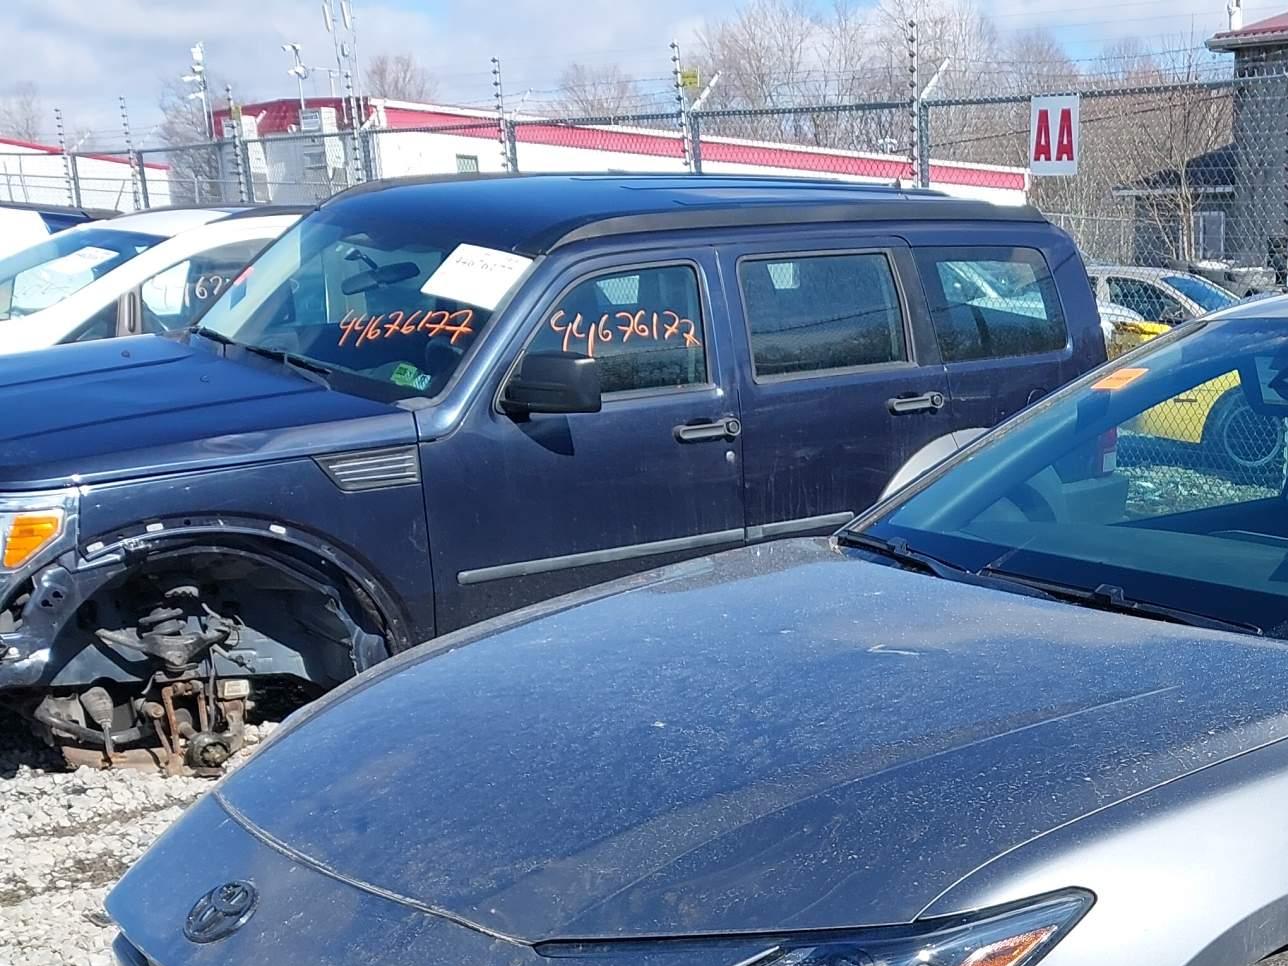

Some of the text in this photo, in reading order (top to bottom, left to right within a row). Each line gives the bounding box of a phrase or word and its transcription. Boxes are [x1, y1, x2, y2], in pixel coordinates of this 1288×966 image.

[1032, 108, 1075, 162] AA
[338, 308, 473, 347] 44676177
[550, 309, 701, 358] 44676177
